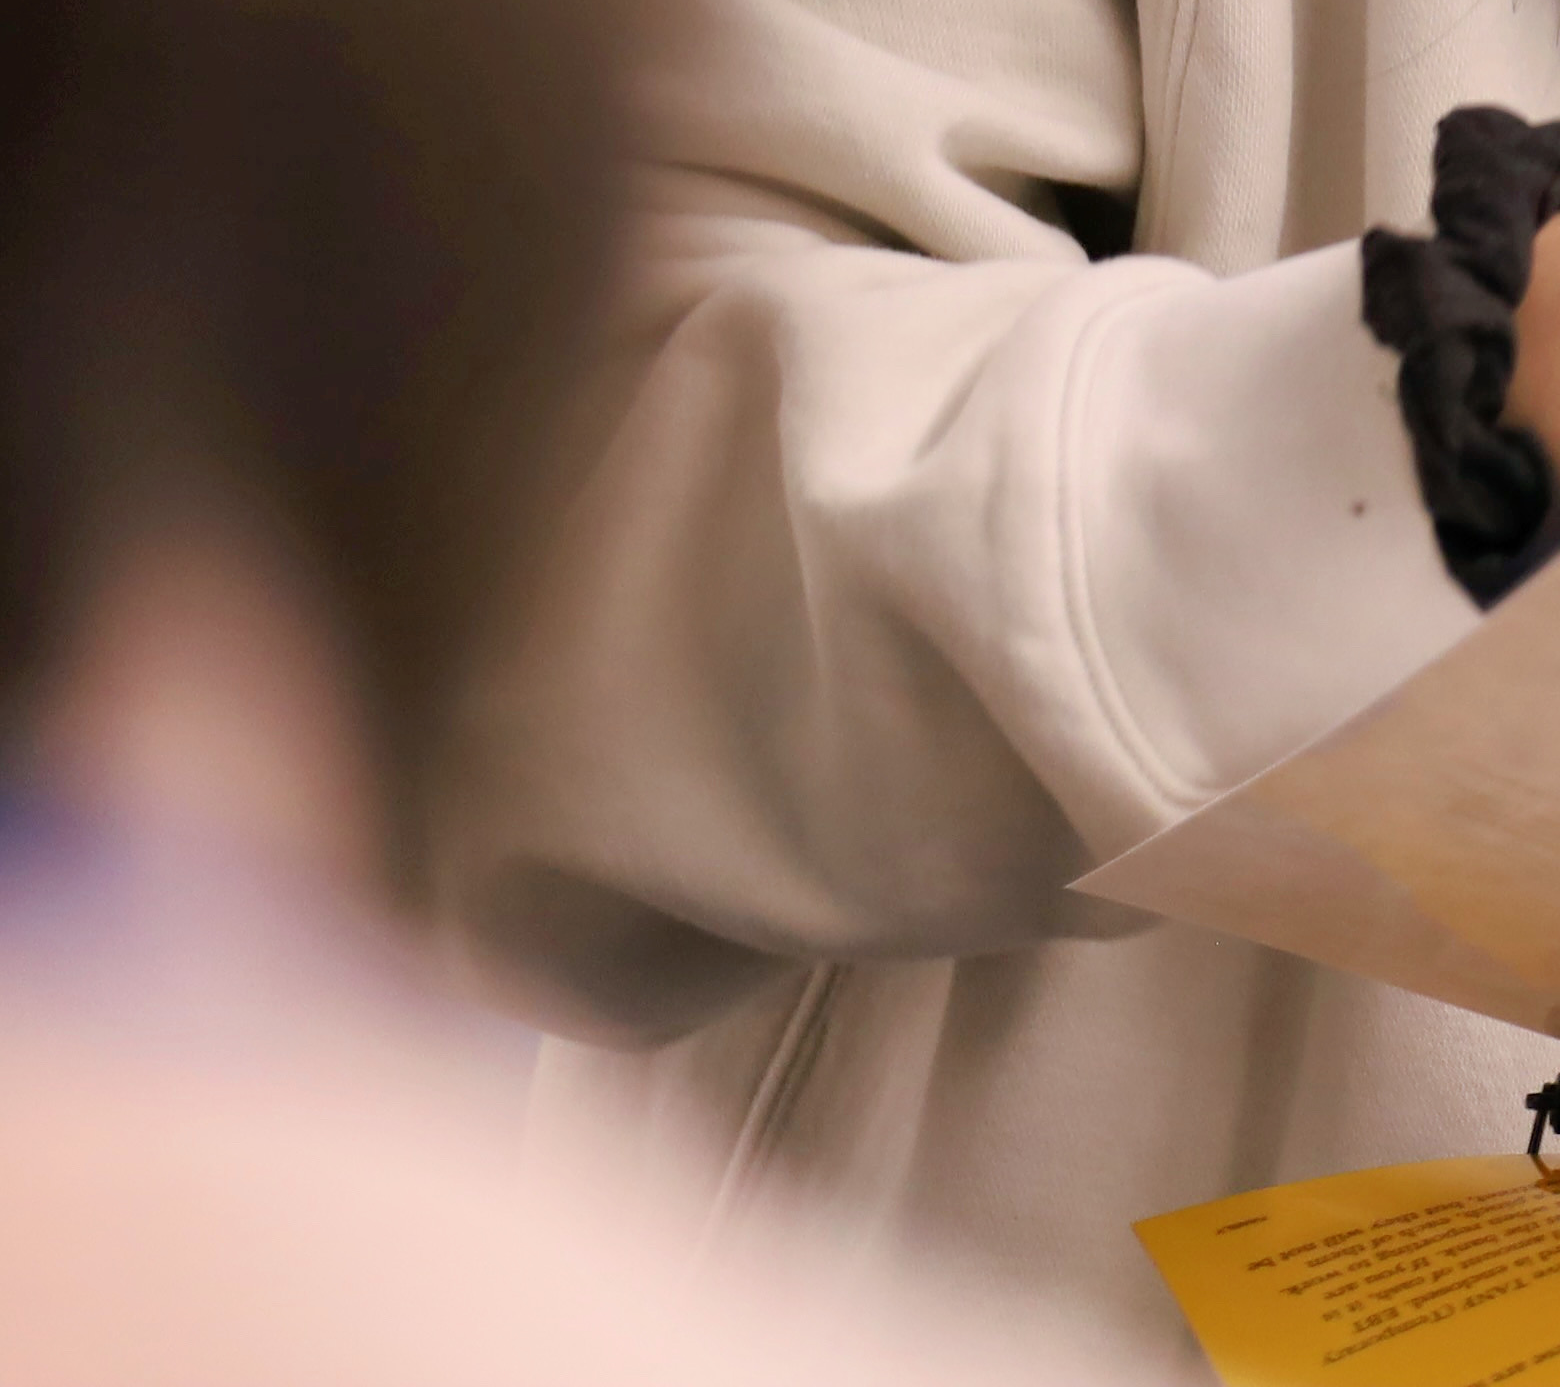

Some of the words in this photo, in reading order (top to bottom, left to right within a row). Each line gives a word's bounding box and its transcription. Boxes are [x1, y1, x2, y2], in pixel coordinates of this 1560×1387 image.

[1370, 1211, 1420, 1231] they
[1398, 1217, 1452, 1238] each
[1503, 1221, 1541, 1237] the
[1321, 1228, 1365, 1248] will
[1370, 1234, 1393, 1251] of
[1375, 1222, 1483, 1263] reporting
[1279, 1241, 1318, 1262] not
[1304, 1242, 1367, 1269] them
[1246, 1255, 1277, 1272] be
[1347, 1258, 1372, 1273] to
[1364, 1262, 1408, 1285] you
[1279, 1270, 1343, 1297] work.
[1323, 1282, 1359, 1300] are
[1462, 1278, 1529, 1311] TANF
[1352, 1306, 1400, 1334] EBT
[1321, 1302, 1456, 1367] (Temporary
